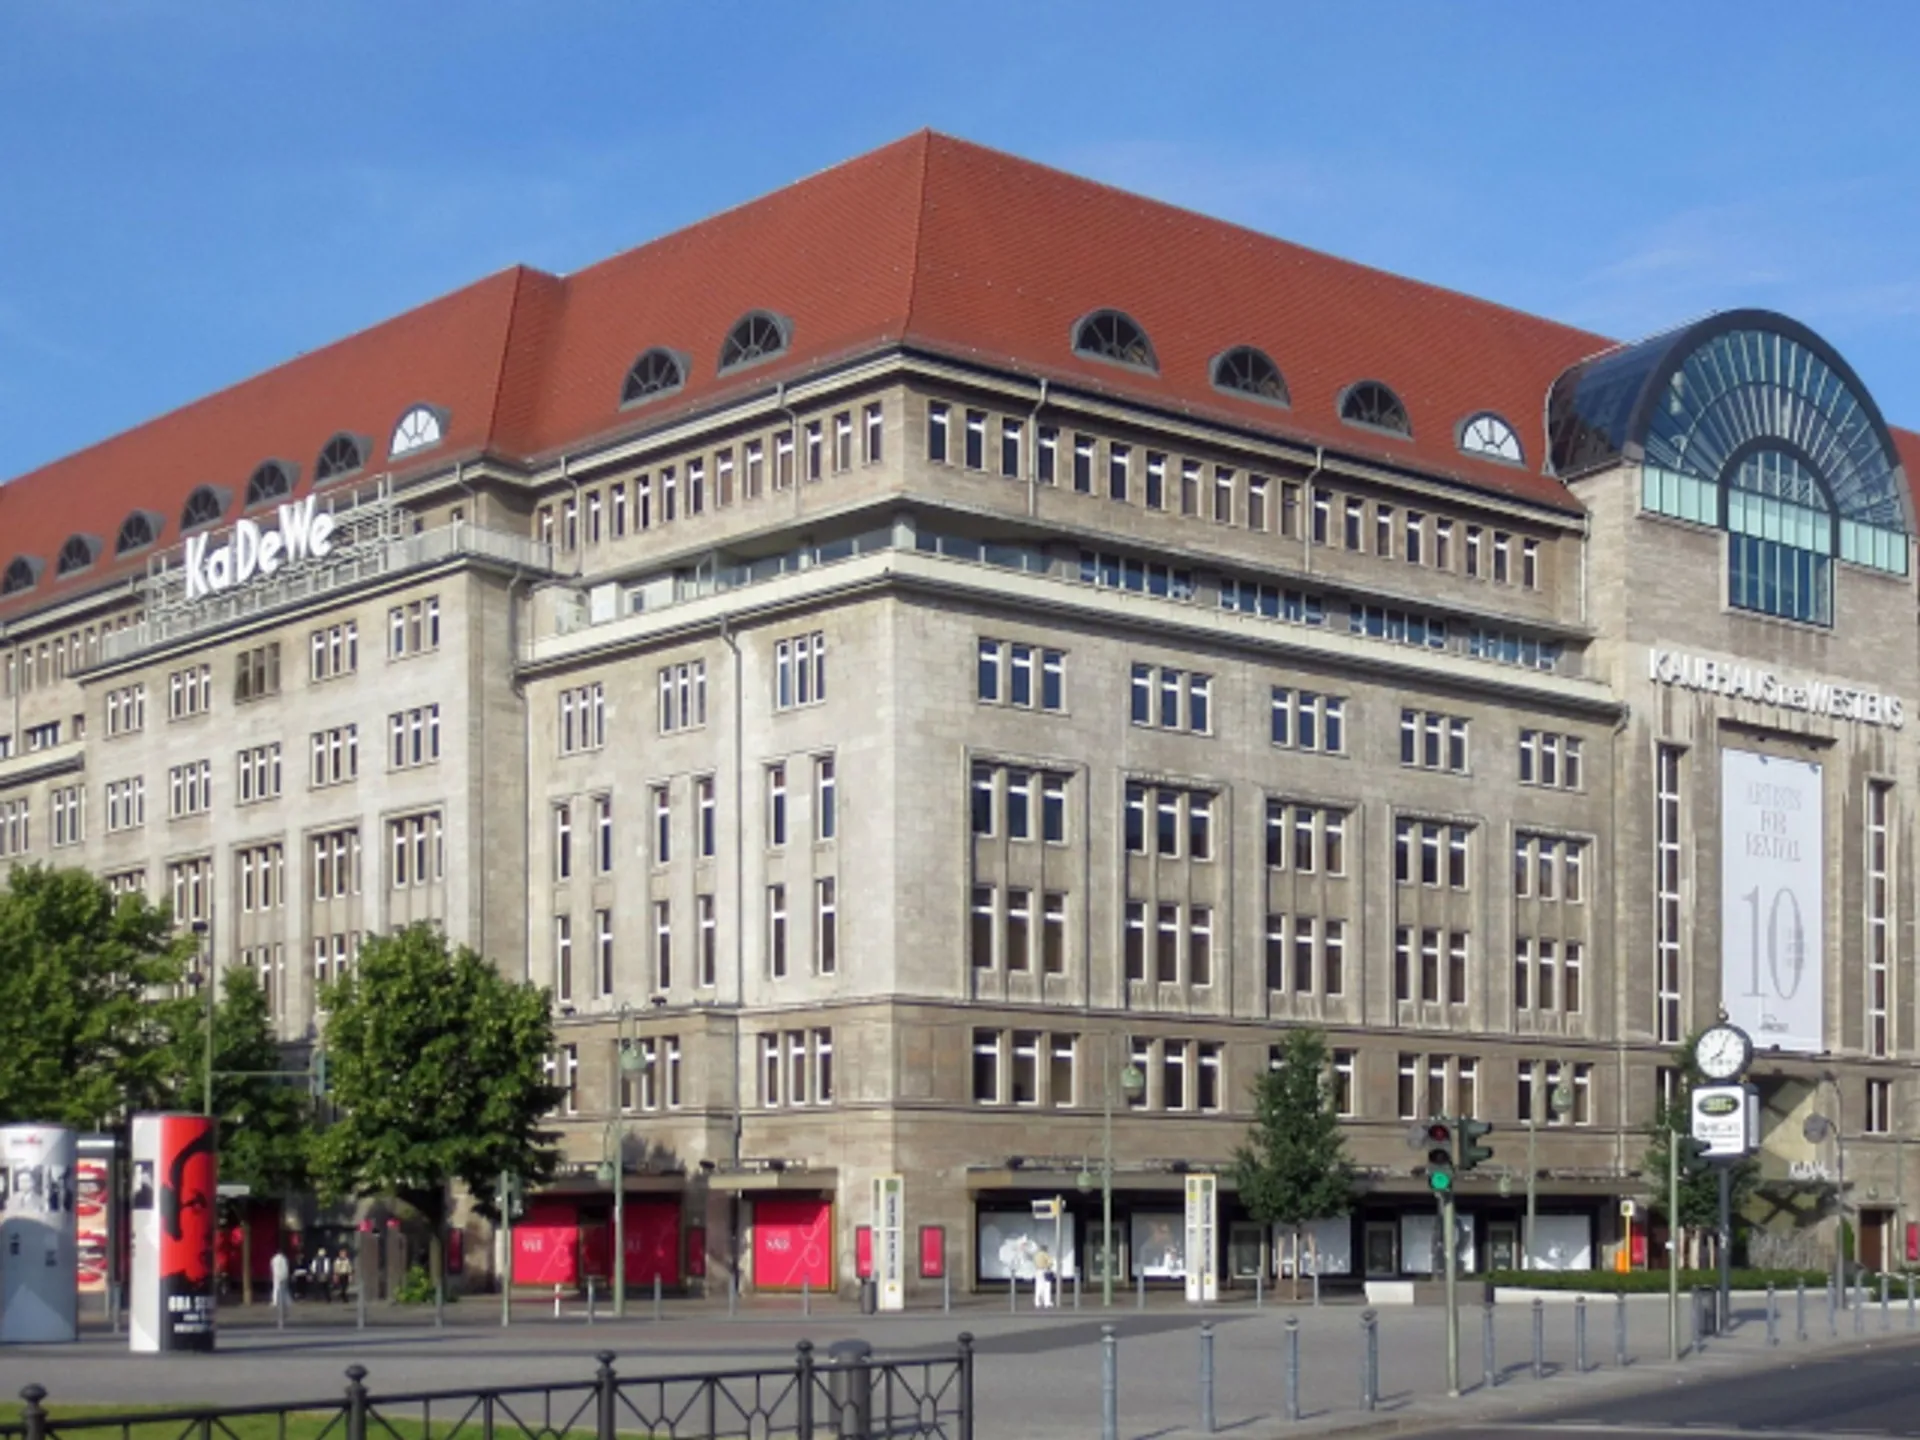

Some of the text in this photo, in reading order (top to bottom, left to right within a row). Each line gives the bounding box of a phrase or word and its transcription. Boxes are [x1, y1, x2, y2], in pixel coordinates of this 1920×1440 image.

[185, 493, 334, 600] KaDeWe
[1648, 648, 1778, 703] KAUFHAUS
[1805, 680, 1904, 727] WESTENS
[1741, 885, 1804, 1000] 10
